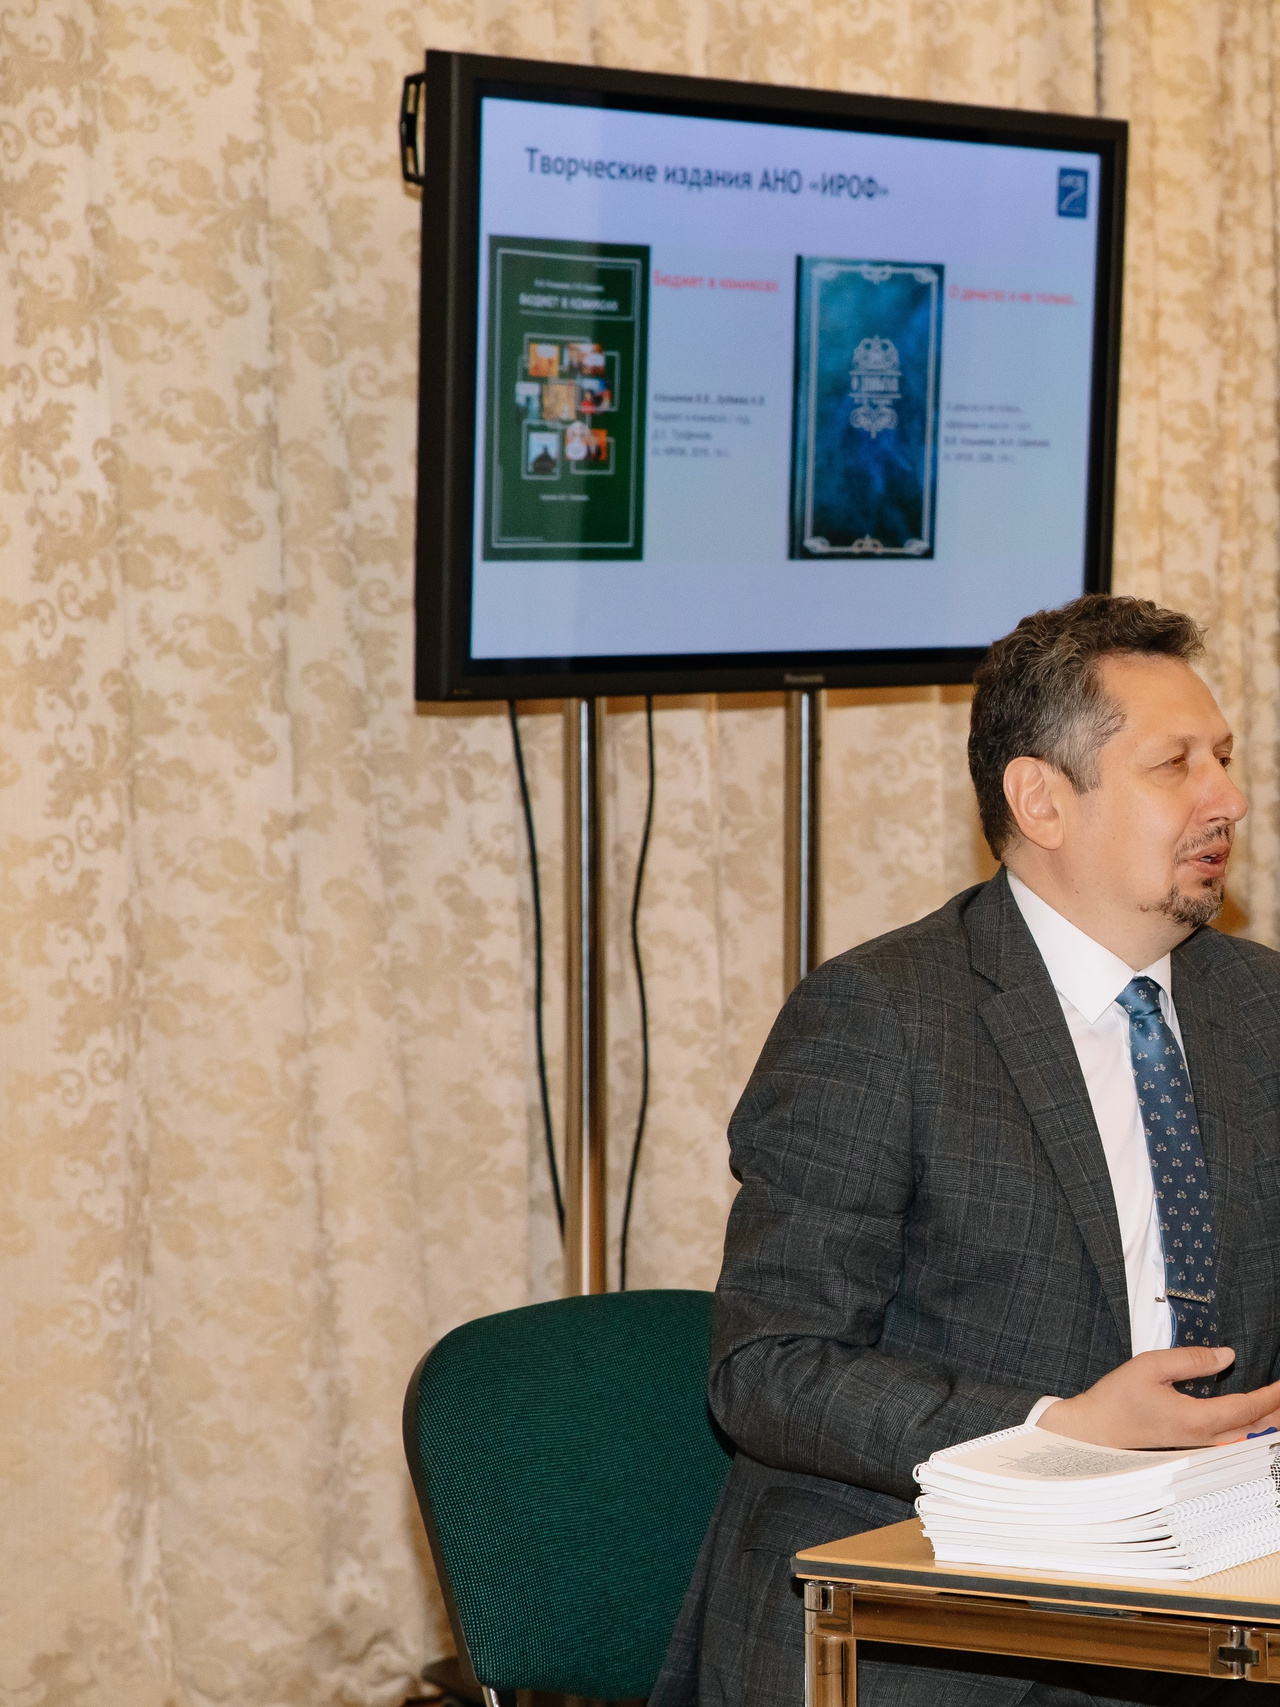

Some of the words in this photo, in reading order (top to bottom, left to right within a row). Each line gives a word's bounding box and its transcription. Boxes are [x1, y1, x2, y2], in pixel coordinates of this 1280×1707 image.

[525, 147, 657, 182] Творческие
[663, 161, 753, 192] издания
[758, 168, 802, 194] АНО
[808, 171, 890, 198] «ИРОФ»
